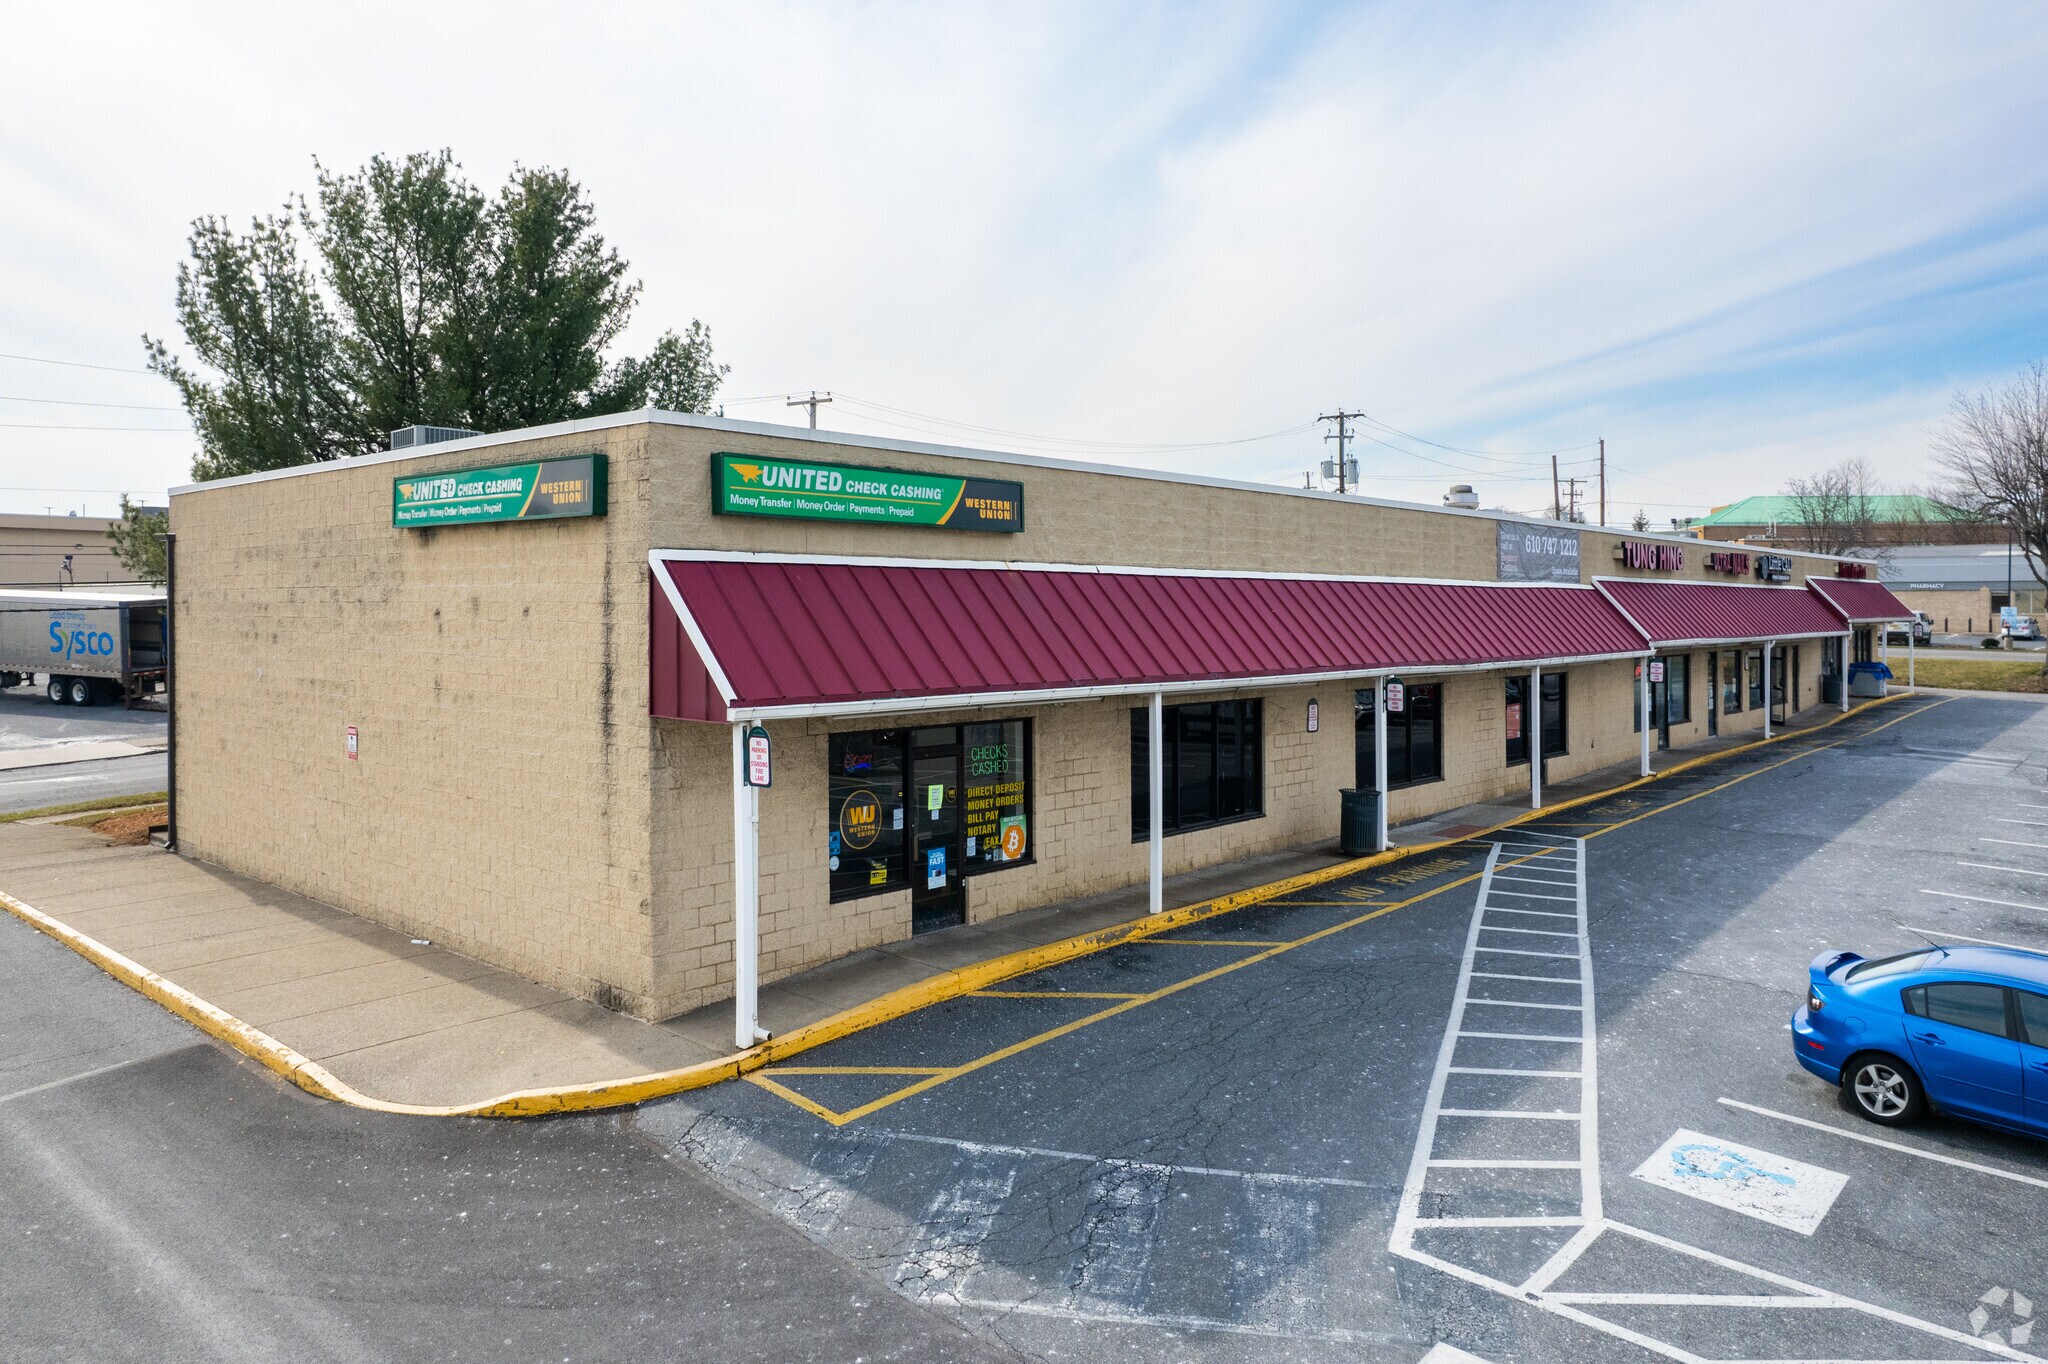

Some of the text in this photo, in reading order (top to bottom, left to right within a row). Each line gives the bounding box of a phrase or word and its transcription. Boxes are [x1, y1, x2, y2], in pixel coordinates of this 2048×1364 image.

[413, 478, 523, 501] UNITED CHECK CASHING
[540, 480, 582, 494] WESTERN
[762, 465, 942, 500] UNITED CHECK CASHING
[552, 492, 582, 505] UNION
[730, 494, 914, 517] Money Transfer Money Order Payments Prepaid
[965, 497, 1011, 511] WESTERN
[398, 503, 502, 520] Money Transfer Money Order Payments Prepaid
[979, 509, 1011, 520] UNION
[1525, 534, 1578, 556] 610 747 1212
[1625, 541, 1684, 570] TUNG HING
[971, 743, 1009, 761] CHECKS
[971, 759, 1009, 777] CASHED
[967, 781, 1025, 799] DIRECT DEPOSIT
[967, 794, 1024, 811] MONEY ORDERS
[967, 810, 999, 824] BILL PAY
[849, 824, 875, 834] WESTERN
[857, 830, 875, 838] UNION
[967, 823, 997, 837] NOTARY
[929, 856, 945, 866] FAST
[1336, 858, 1471, 900] NO PARKING
